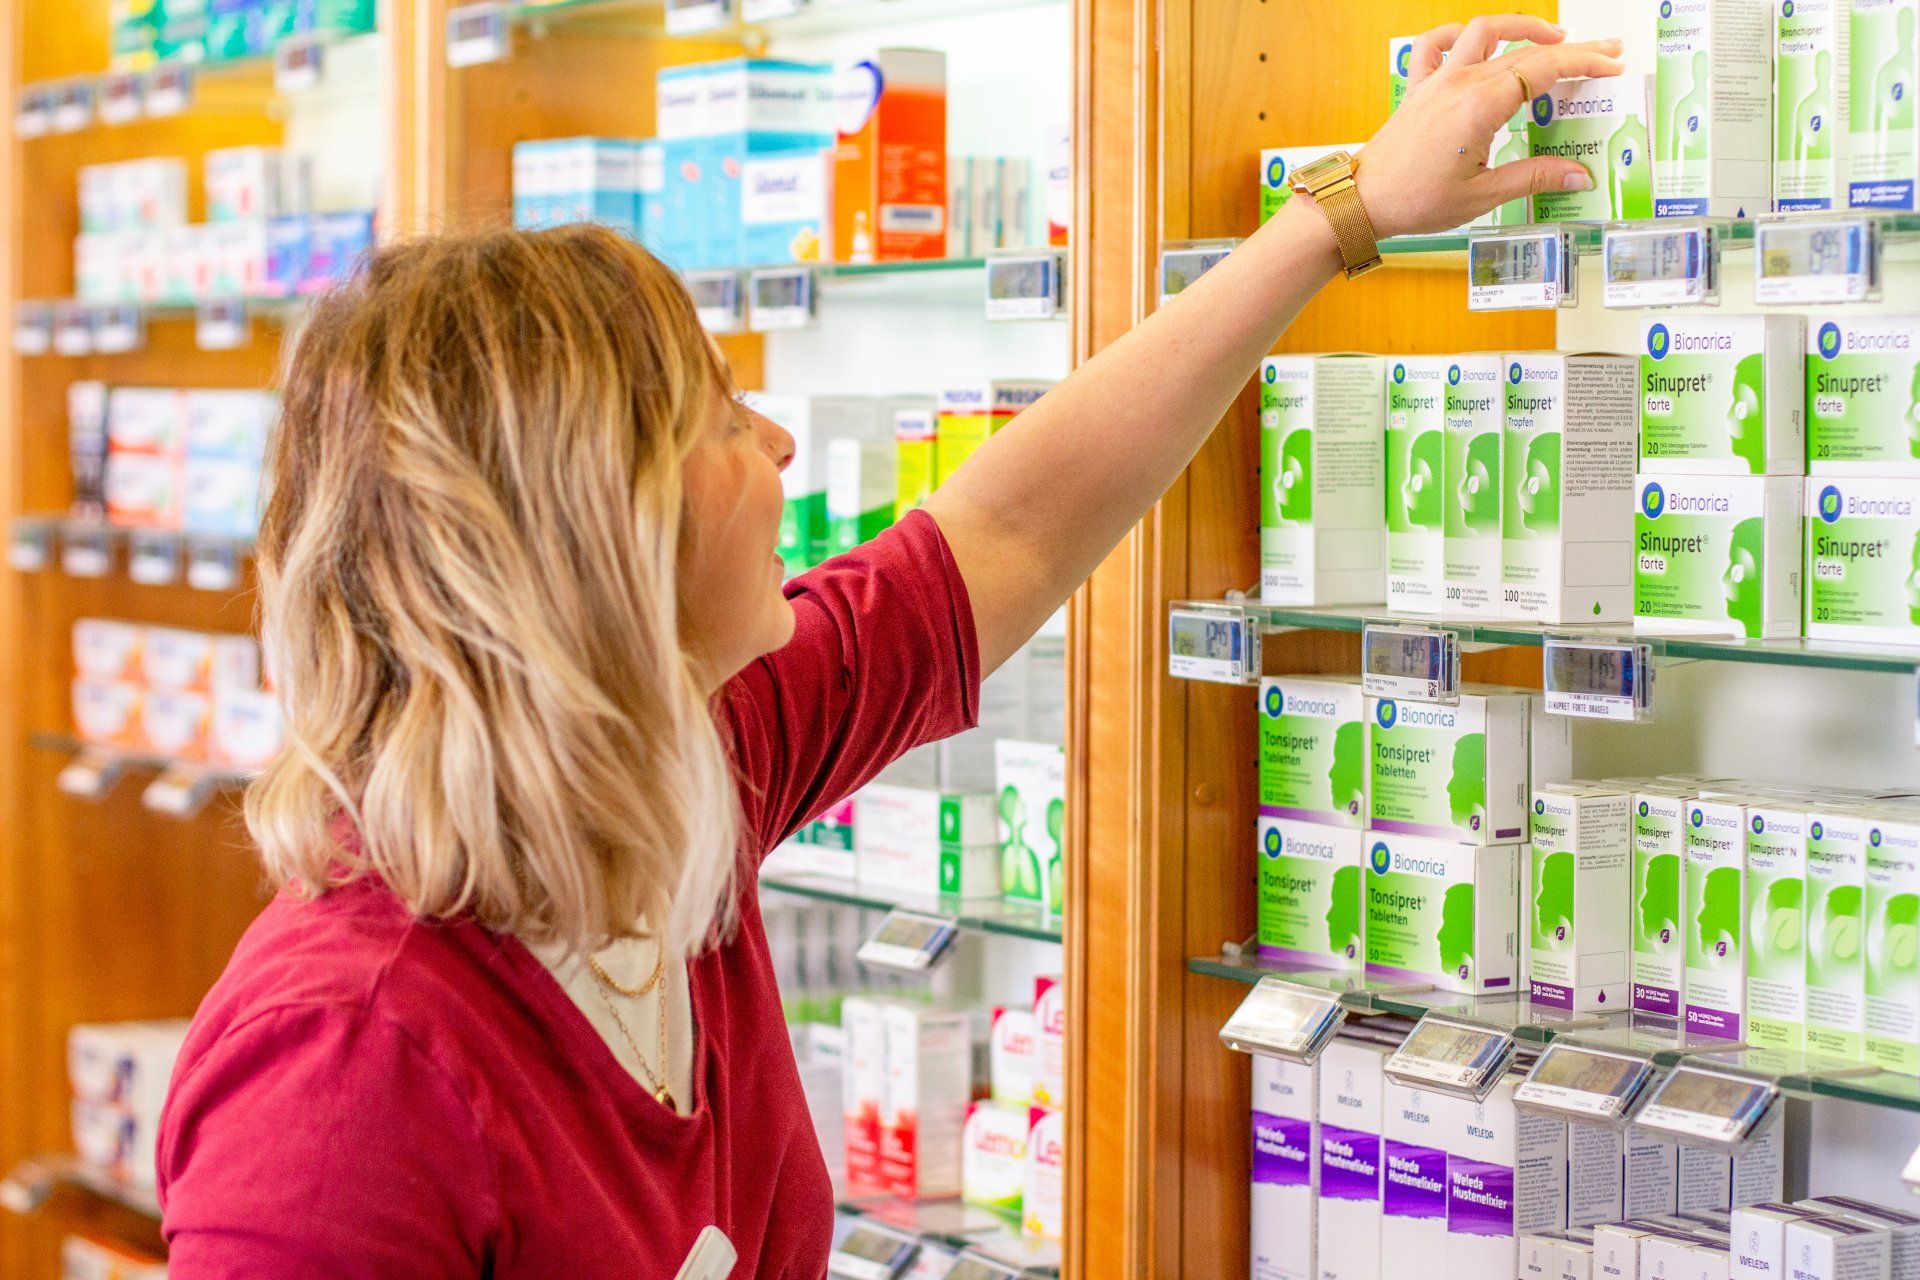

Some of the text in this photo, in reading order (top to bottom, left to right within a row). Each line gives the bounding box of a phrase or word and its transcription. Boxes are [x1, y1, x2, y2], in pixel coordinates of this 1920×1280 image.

[1659, 28, 1700, 38] Bronchipret
[1781, 26, 1822, 38] Bronchipret
[1660, 42, 1686, 54] Tropfen
[1782, 42, 1808, 54] Tropfen
[1558, 96, 1614, 116] Bionorica
[1539, 206, 1550, 219] 20
[1658, 204, 1668, 216] 50
[1674, 332, 1732, 350] Bionorica
[1848, 331, 1910, 350] Bionorica
[1408, 368, 1440, 380] Bionorica
[1463, 368, 1496, 381] Bionorica
[1524, 367, 1558, 380] Bionorica
[1647, 398, 1670, 411] forte
[1817, 399, 1842, 412] forte
[1448, 418, 1473, 429] Tropfen
[1508, 417, 1534, 429] Tropfen
[1648, 442, 1658, 454] 20
[1818, 444, 1830, 458] 20
[1670, 493, 1729, 512] Bionorica
[1848, 496, 1912, 516] Bionorica
[1640, 556, 1664, 570] forte
[1818, 562, 1842, 576] forte
[1264, 574, 1278, 586] 100
[1392, 582, 1406, 593] 100
[1446, 587, 1460, 600] 100
[1504, 590, 1518, 602] 100
[1640, 600, 1651, 614] 20
[1817, 608, 1829, 620] 20
[1287, 696, 1336, 716] Bionorica
[1401, 706, 1455, 727] Bionorica
[1376, 763, 1416, 779] Tabletten
[1376, 804, 1386, 816] 50
[1546, 804, 1571, 816] Bionorica
[1650, 806, 1677, 818] Bionorica
[1706, 815, 1738, 829] Bionorica
[1767, 821, 1800, 835] Bionorica
[1826, 828, 1860, 841] Bionorica
[1286, 837, 1334, 859] Bionorica
[1534, 837, 1555, 848] Tropfen
[1638, 840, 1659, 850] Tropfen
[1690, 850, 1713, 862] Tropfen
[1790, 847, 1798, 858] N
[1848, 854, 1856, 864] N
[1394, 853, 1446, 876] Bionorica
[1751, 857, 1774, 868] Tropfen
[1370, 908, 1408, 926] Tabletten
[1370, 948, 1380, 961] 50
[1532, 984, 1542, 996] 30
[1636, 988, 1645, 999] 30
[1688, 1010, 1698, 1022] 50
[1750, 1022, 1760, 1033] 50
[1808, 1031, 1817, 1042] 50
[1270, 1082, 1294, 1095] WELEDA
[1338, 1094, 1363, 1108] WELEDA
[1402, 1110, 1430, 1124] WELEDA
[1256, 1126, 1286, 1145] Weleda
[1466, 1124, 1494, 1140] WELEDA
[1324, 1138, 1354, 1157] Weleda
[1323, 1152, 1376, 1176] Hustenelixier
[1388, 1155, 1420, 1174] Weleda
[1388, 1169, 1443, 1194] Hustenelixier
[1452, 1171, 1484, 1190] Weleda
[1452, 1188, 1508, 1210] Hustenelixier
[1528, 1264, 1542, 1273] WELEDA
[1740, 1254, 1770, 1272] WELEDA
[1603, 1266, 1620, 1276] WELEDA
